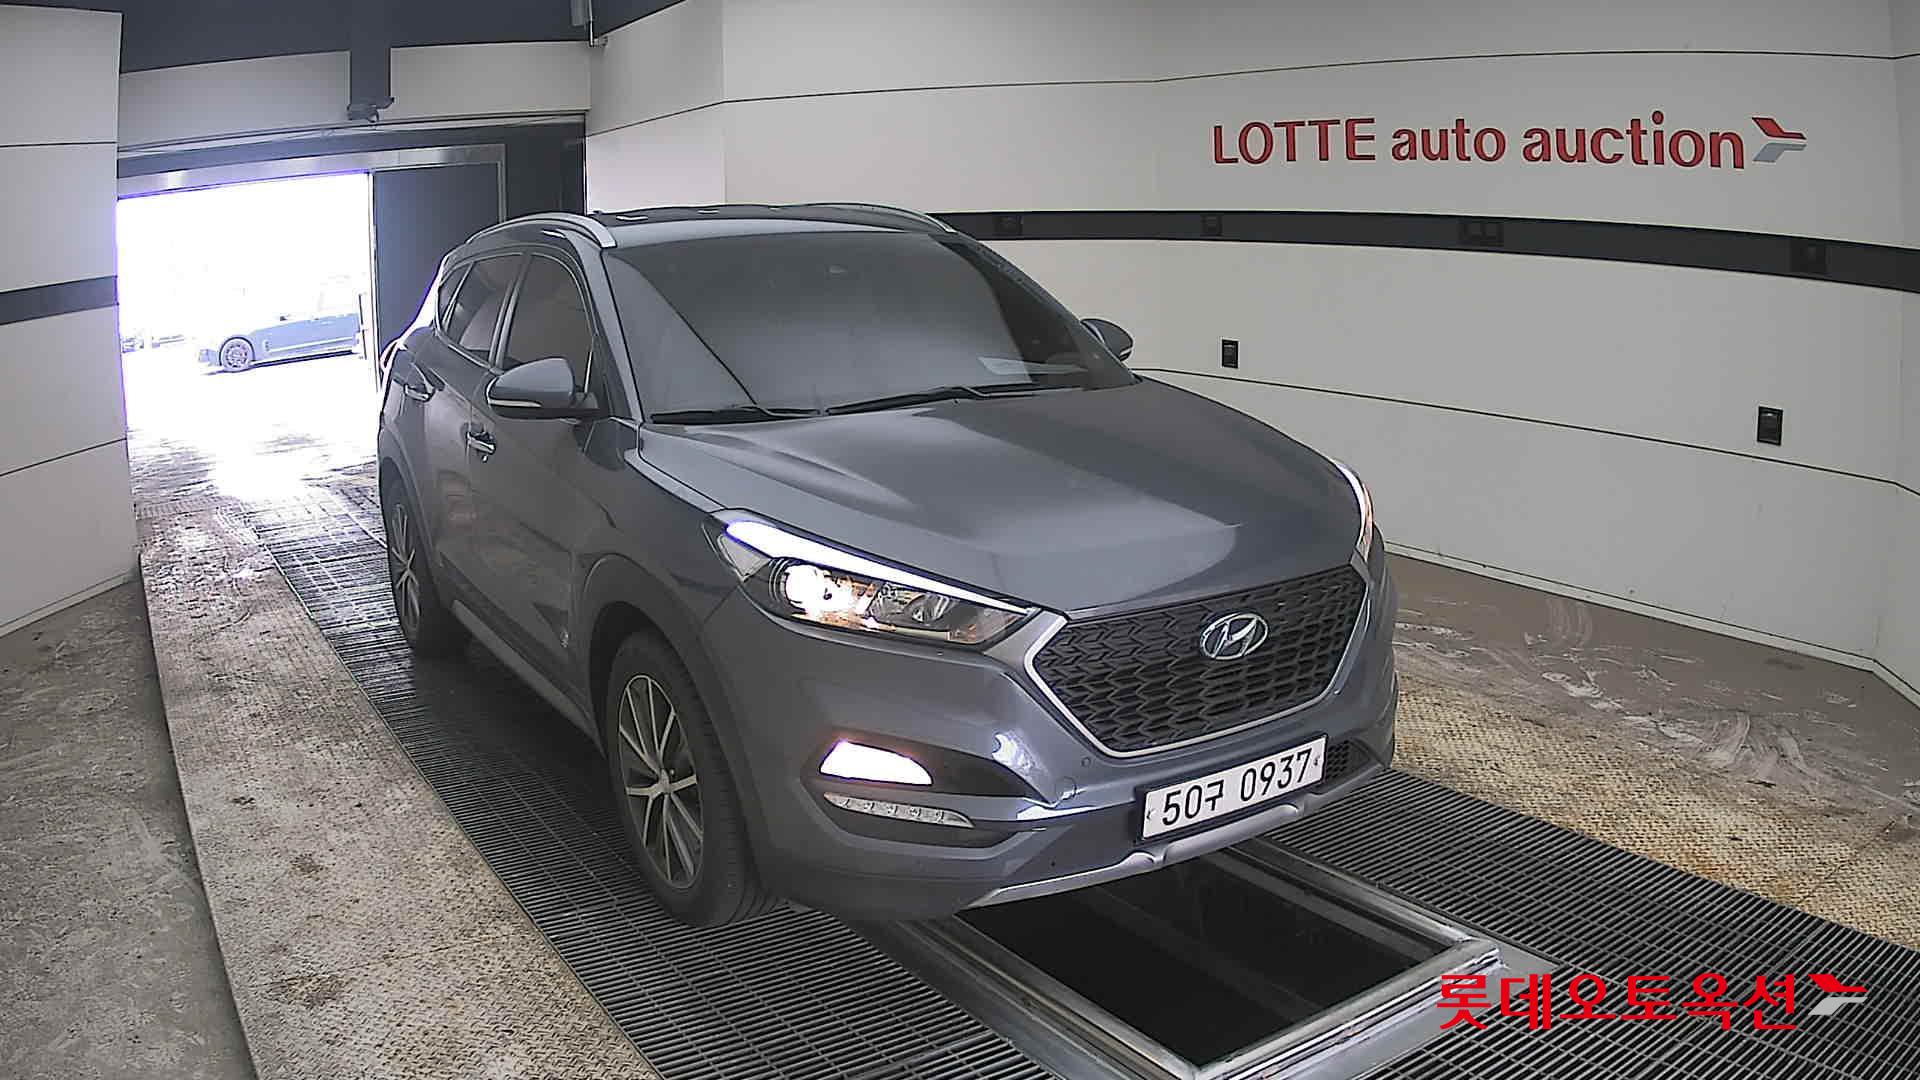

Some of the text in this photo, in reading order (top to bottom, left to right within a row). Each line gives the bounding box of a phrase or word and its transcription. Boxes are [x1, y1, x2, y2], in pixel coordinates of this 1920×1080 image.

[1212, 110, 1746, 170] LOTTE auto auction
[1162, 747, 1313, 826] 50구 0937
